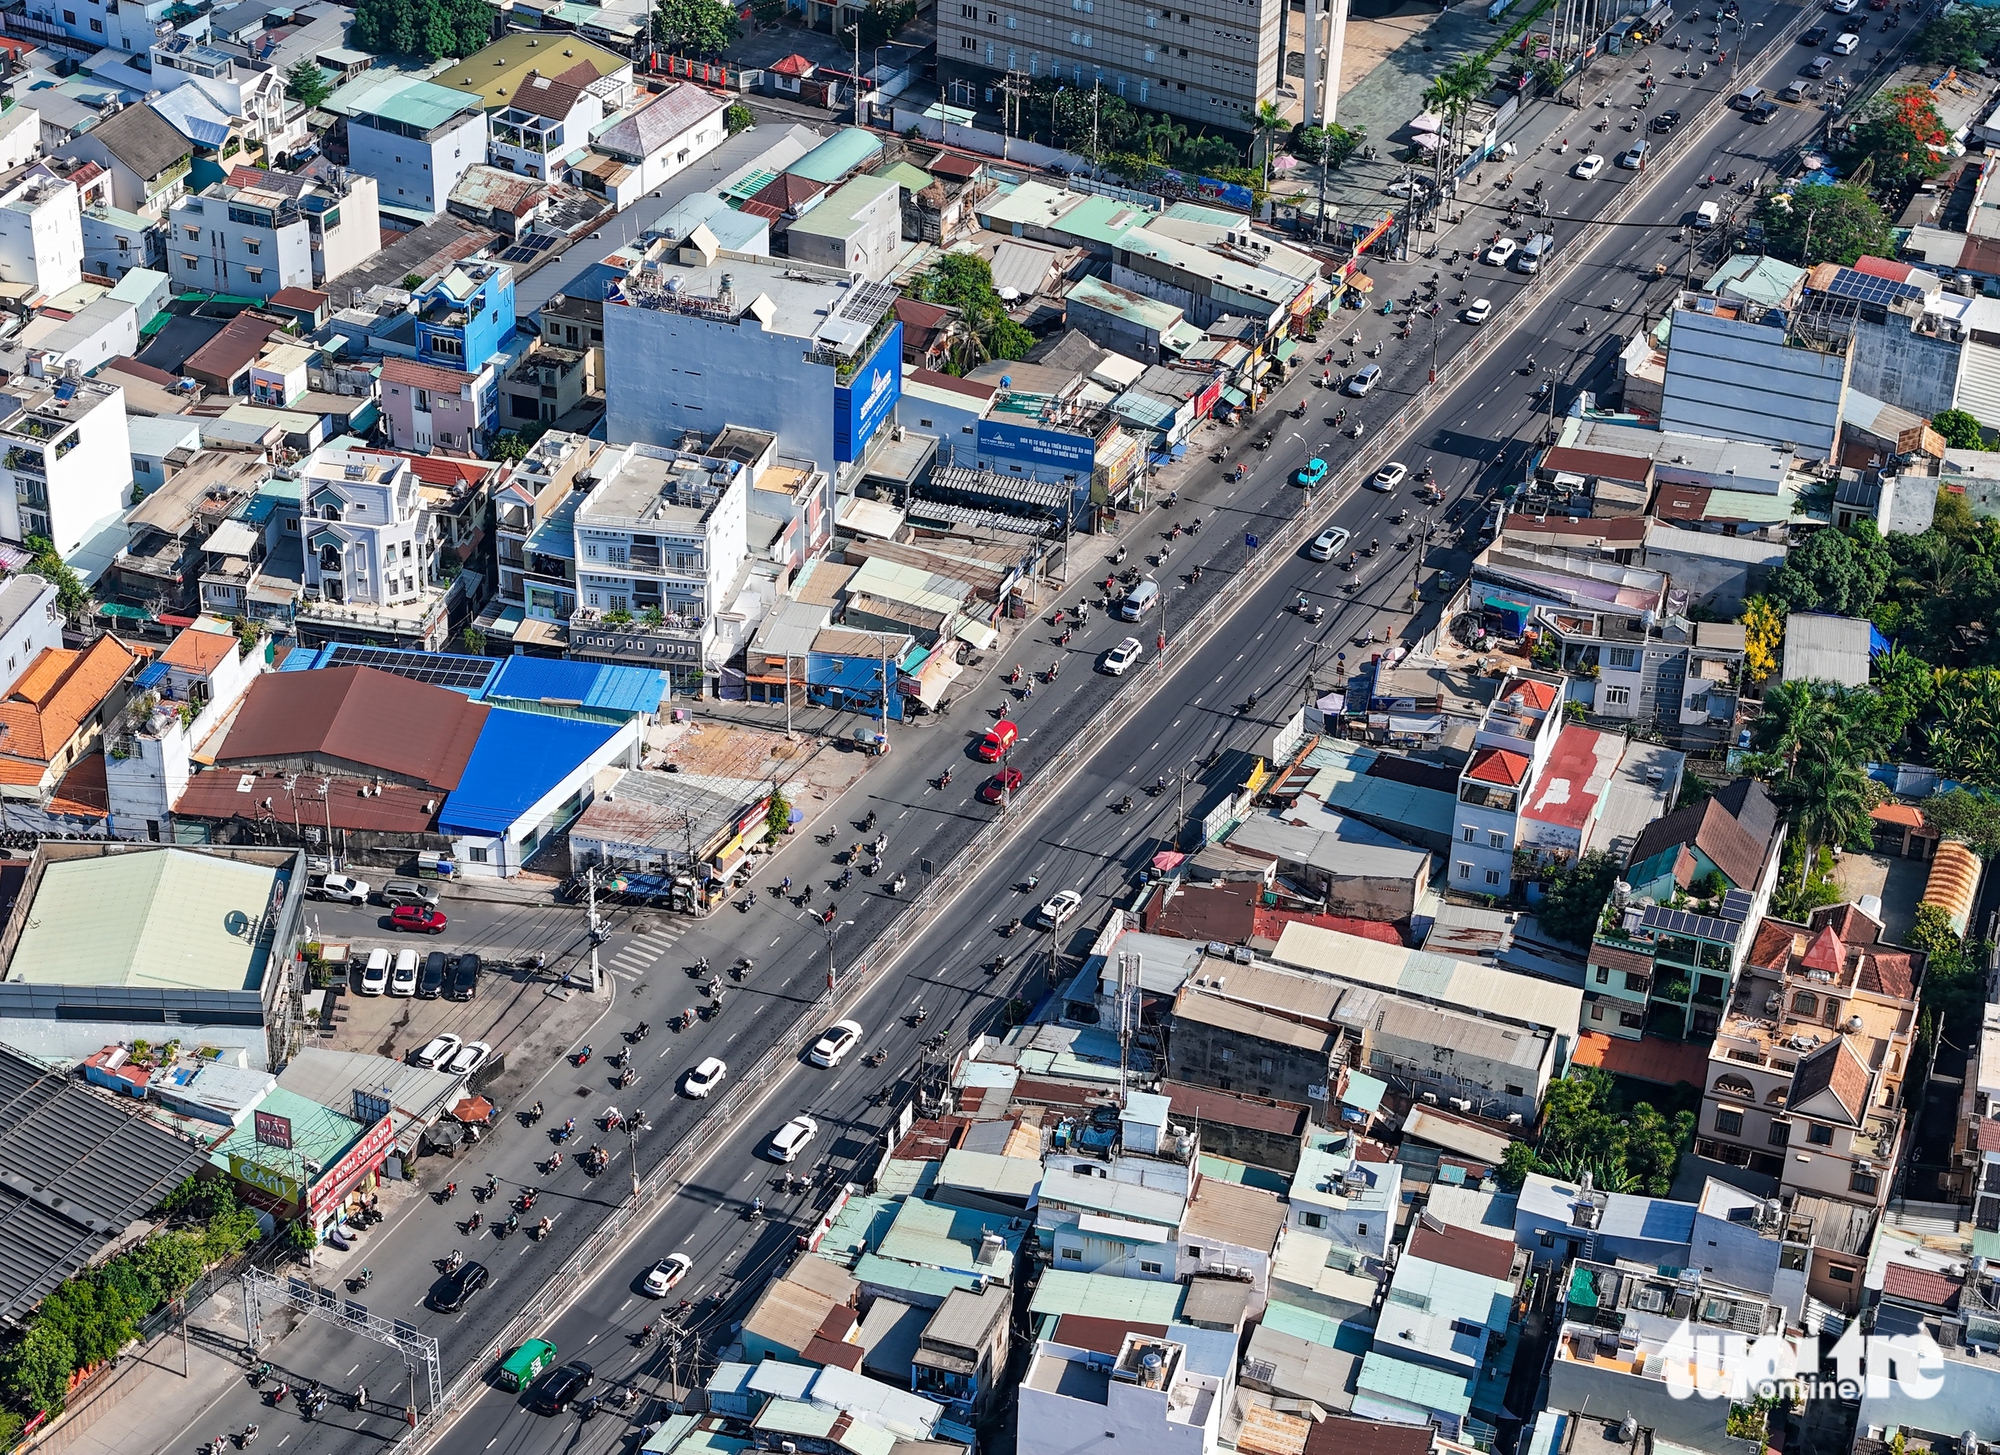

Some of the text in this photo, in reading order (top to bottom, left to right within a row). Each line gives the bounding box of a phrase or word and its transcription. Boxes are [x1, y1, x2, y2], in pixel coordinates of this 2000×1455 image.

[680, 298, 731, 313] SERVICES
[260, 1117, 286, 1134] MẮT
[259, 1131, 289, 1148] KÍNH
[315, 1178, 334, 1202] MẮT
[335, 1156, 355, 1182] KÍNH
[357, 1142, 371, 1159] SÀI
[372, 1124, 390, 1145] GÒN
